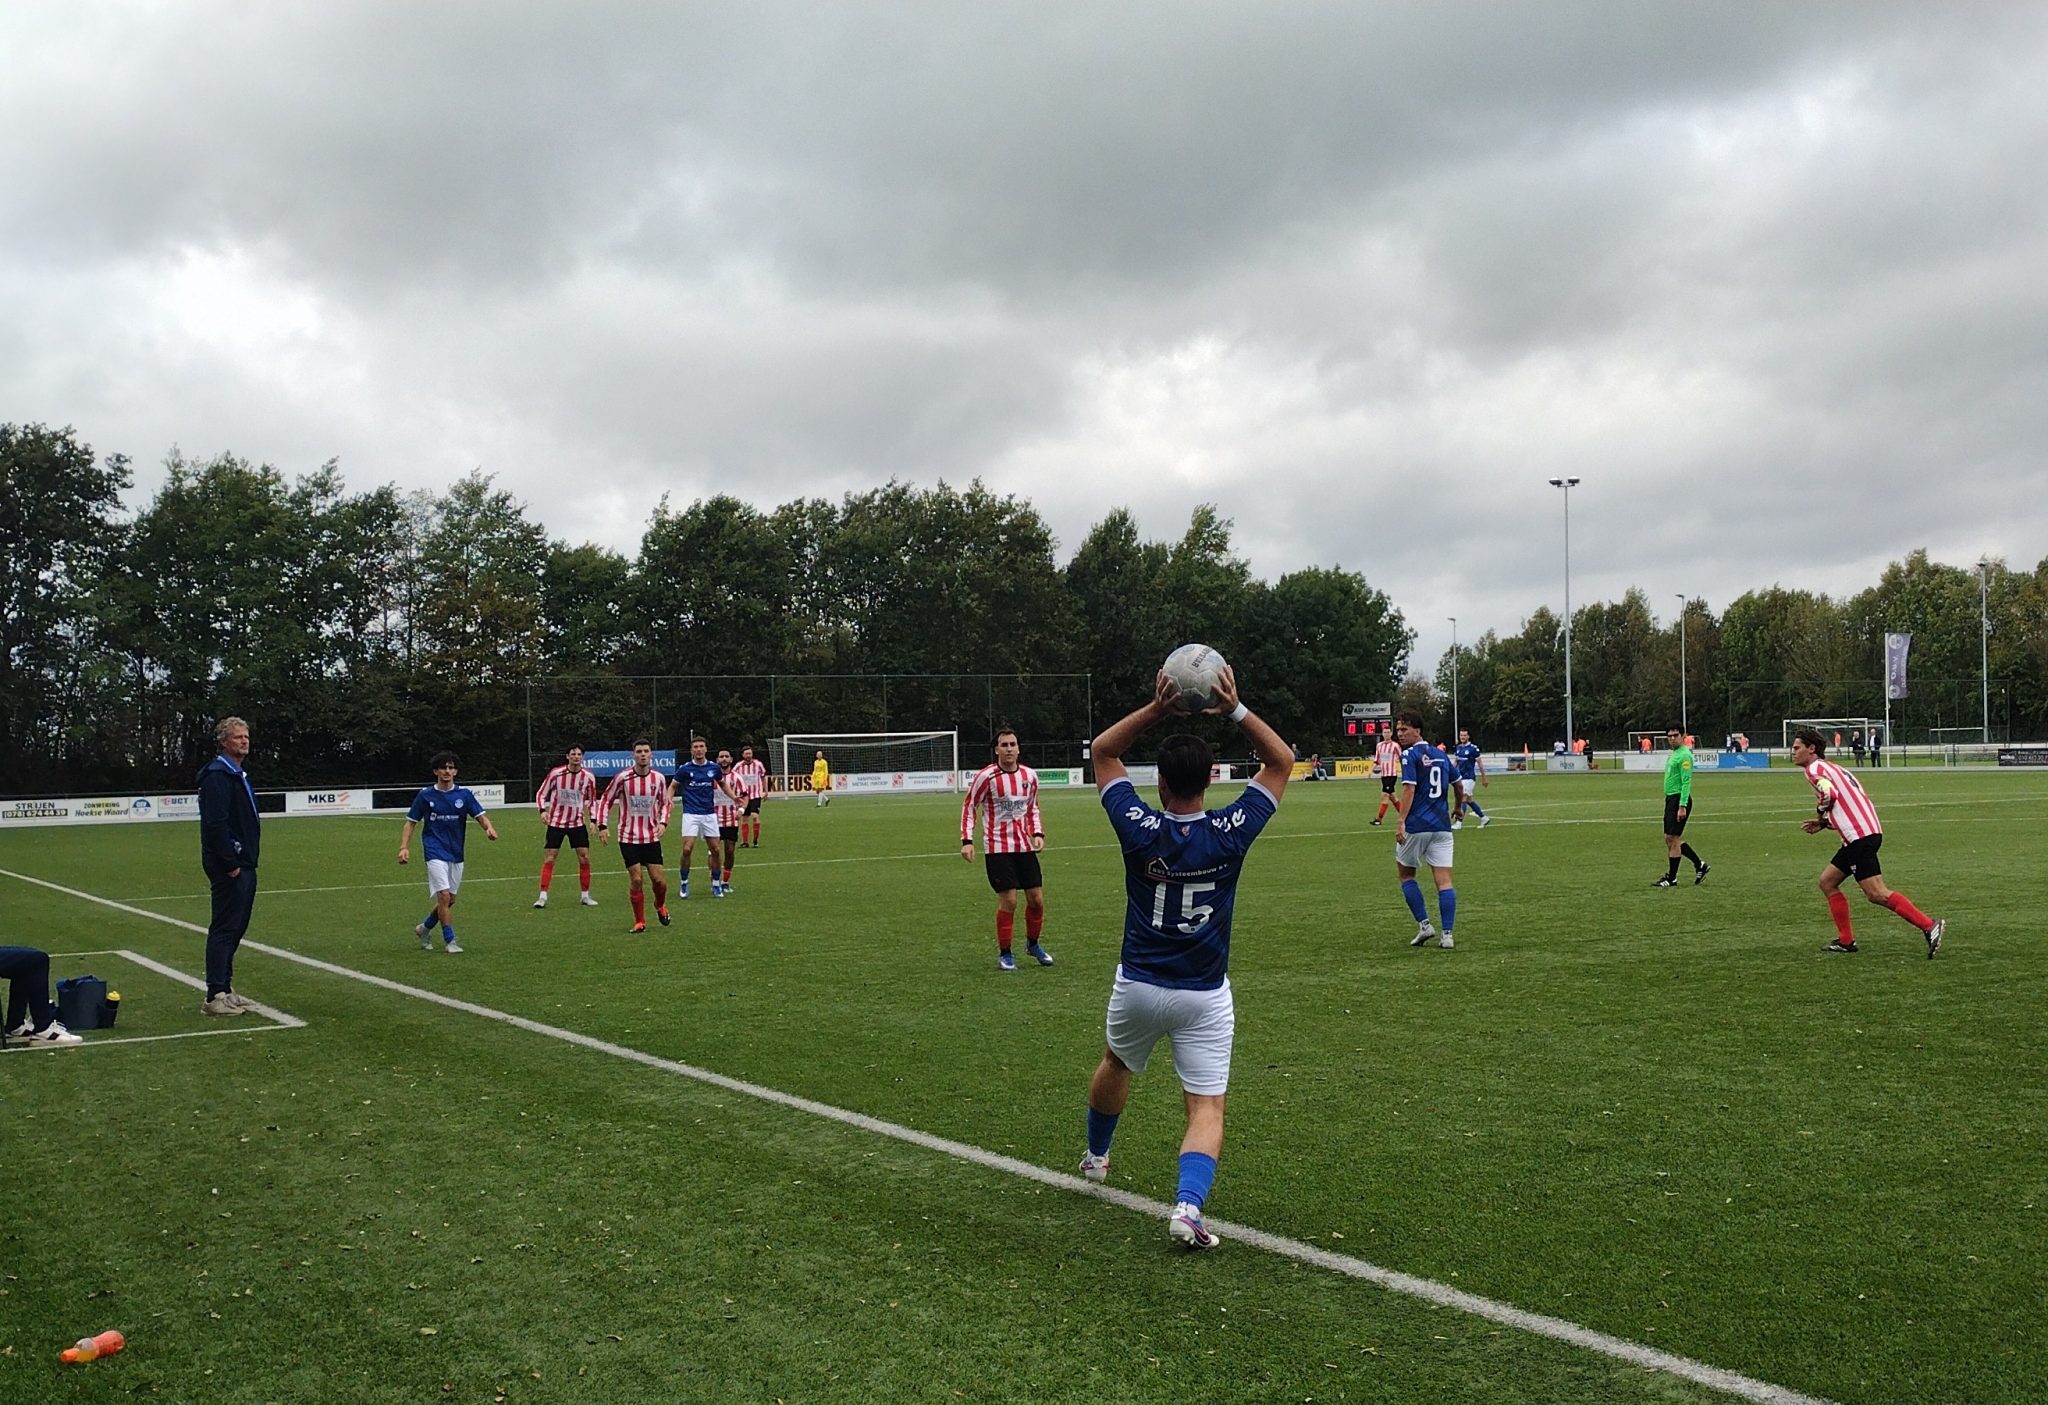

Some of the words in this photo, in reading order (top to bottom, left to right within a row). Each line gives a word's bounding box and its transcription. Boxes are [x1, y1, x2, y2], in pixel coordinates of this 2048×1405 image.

[1694, 754, 1718, 763] STURM
[1340, 763, 1369, 774] Wijntje
[1428, 766, 1442, 799] 9
[308, 794, 336, 804] MKB
[15, 802, 55, 810] STRIJEN
[75, 809, 102, 817] Hoekse
[104, 808, 129, 816] Waard
[1152, 881, 1216, 933] 15
